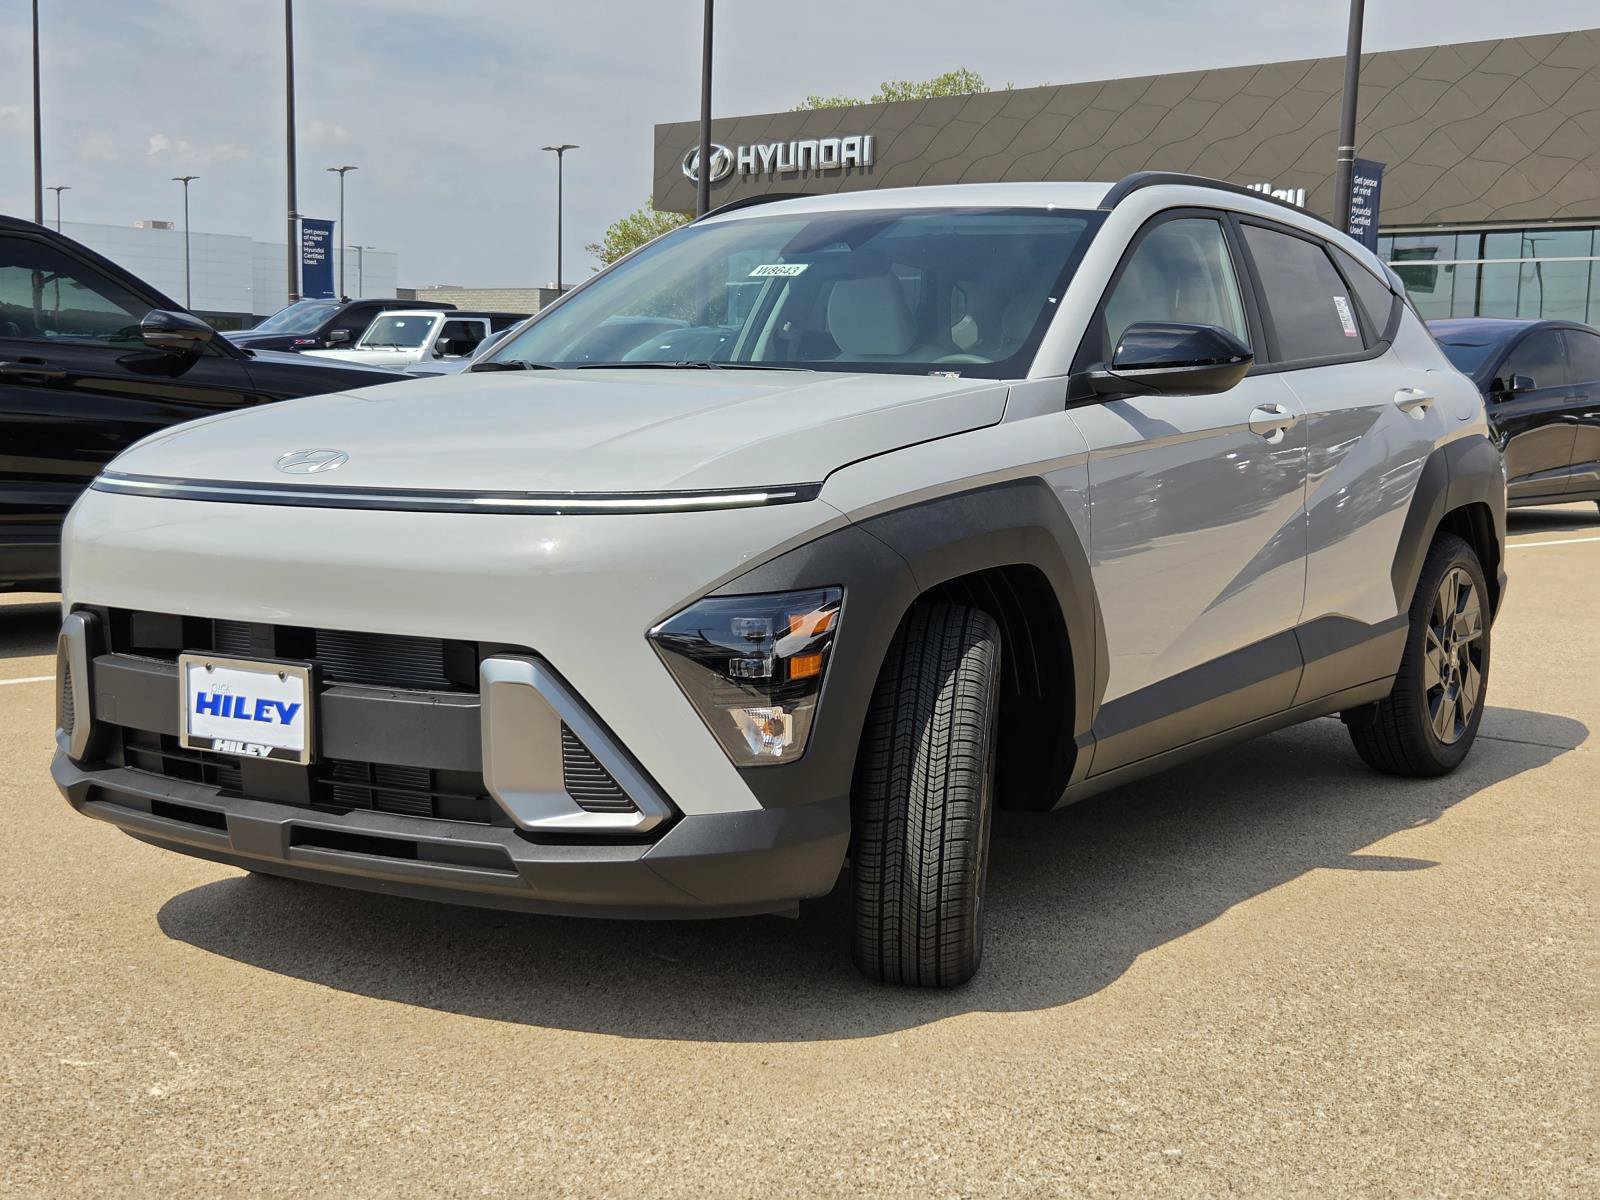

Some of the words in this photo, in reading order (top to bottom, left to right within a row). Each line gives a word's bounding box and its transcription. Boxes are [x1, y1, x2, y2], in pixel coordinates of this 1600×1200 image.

[737, 135, 874, 175] HYUNDAI
[1353, 175, 1363, 184] Get
[1363, 178, 1378, 187] peace
[1353, 185, 1359, 194] of
[1359, 187, 1371, 196] mind
[1352, 195, 1363, 204] with
[1351, 205, 1371, 216] Hyundai
[1350, 215, 1371, 226] Certified
[1350, 225, 1363, 235] Used.
[303, 246, 325, 254] Hyundai
[303, 252, 325, 260] Certified
[755, 266, 800, 275] W8643
[195, 691, 301, 725] HILEY
[213, 739, 274, 758] HILEY
